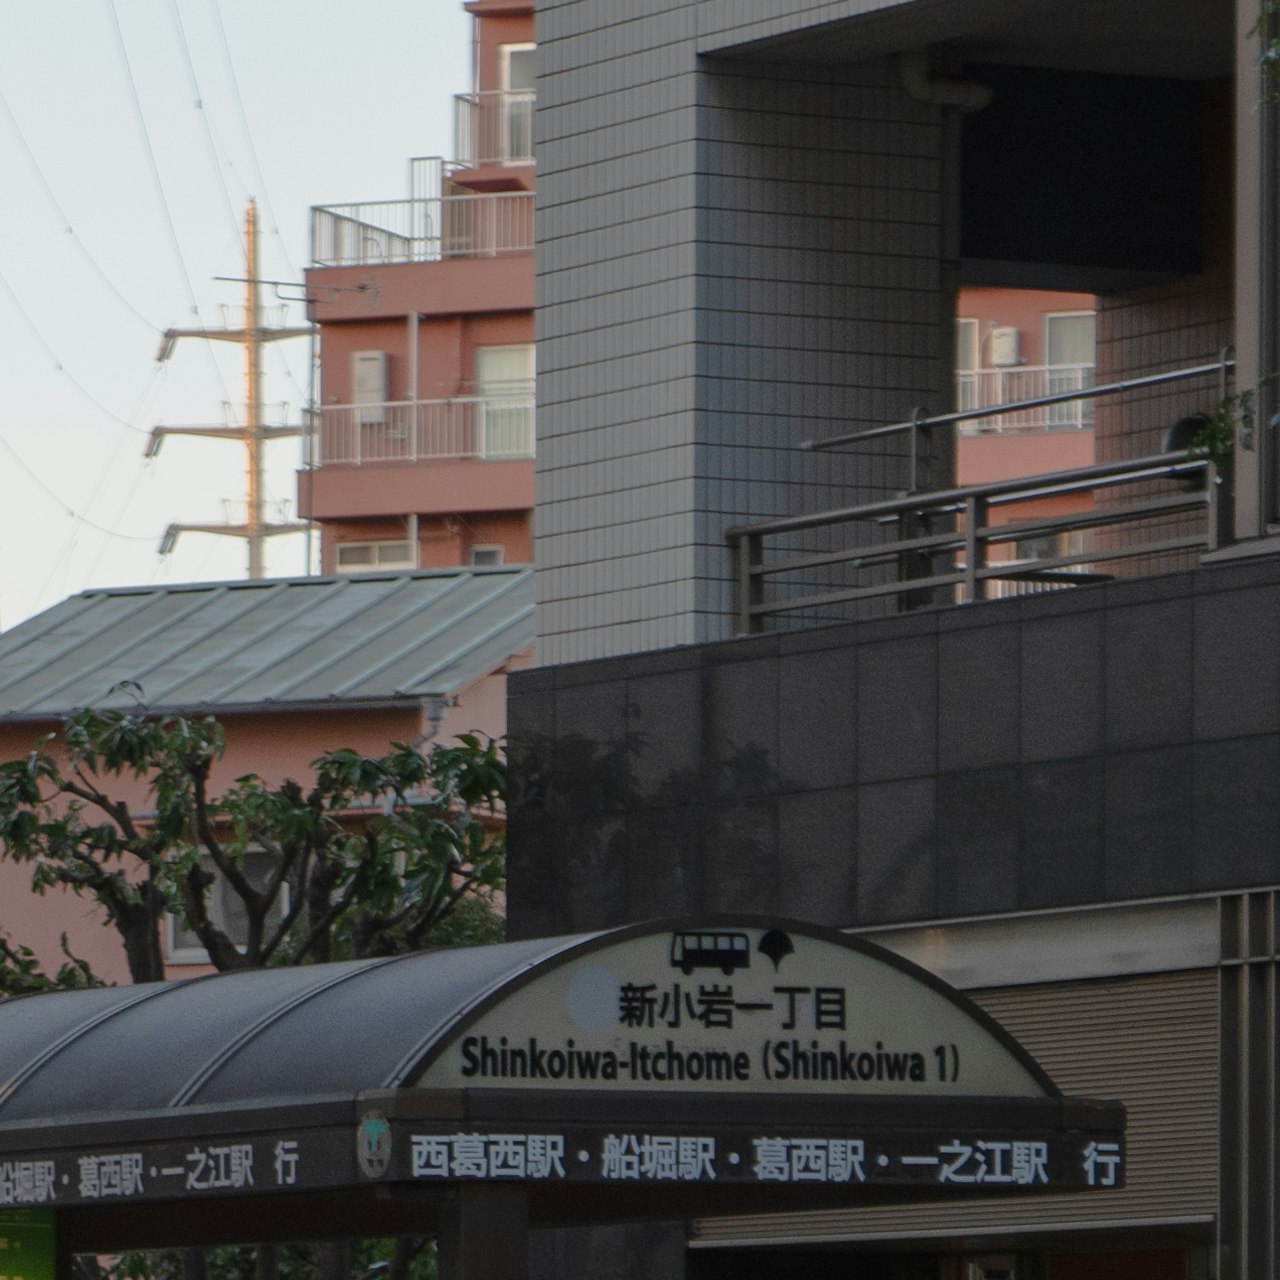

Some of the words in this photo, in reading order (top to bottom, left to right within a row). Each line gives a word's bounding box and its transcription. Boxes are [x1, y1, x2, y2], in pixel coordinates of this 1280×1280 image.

[618, 985, 848, 1029] 新小岩一丁目
[461, 1037, 751, 1081] Shinkoiwa-Itchome
[761, 1041, 925, 1084] (Shinkoiwa
[931, 1045, 961, 1083] 1)
[272, 1140, 299, 1185] 行
[1084, 1142, 1120, 1186] 行
